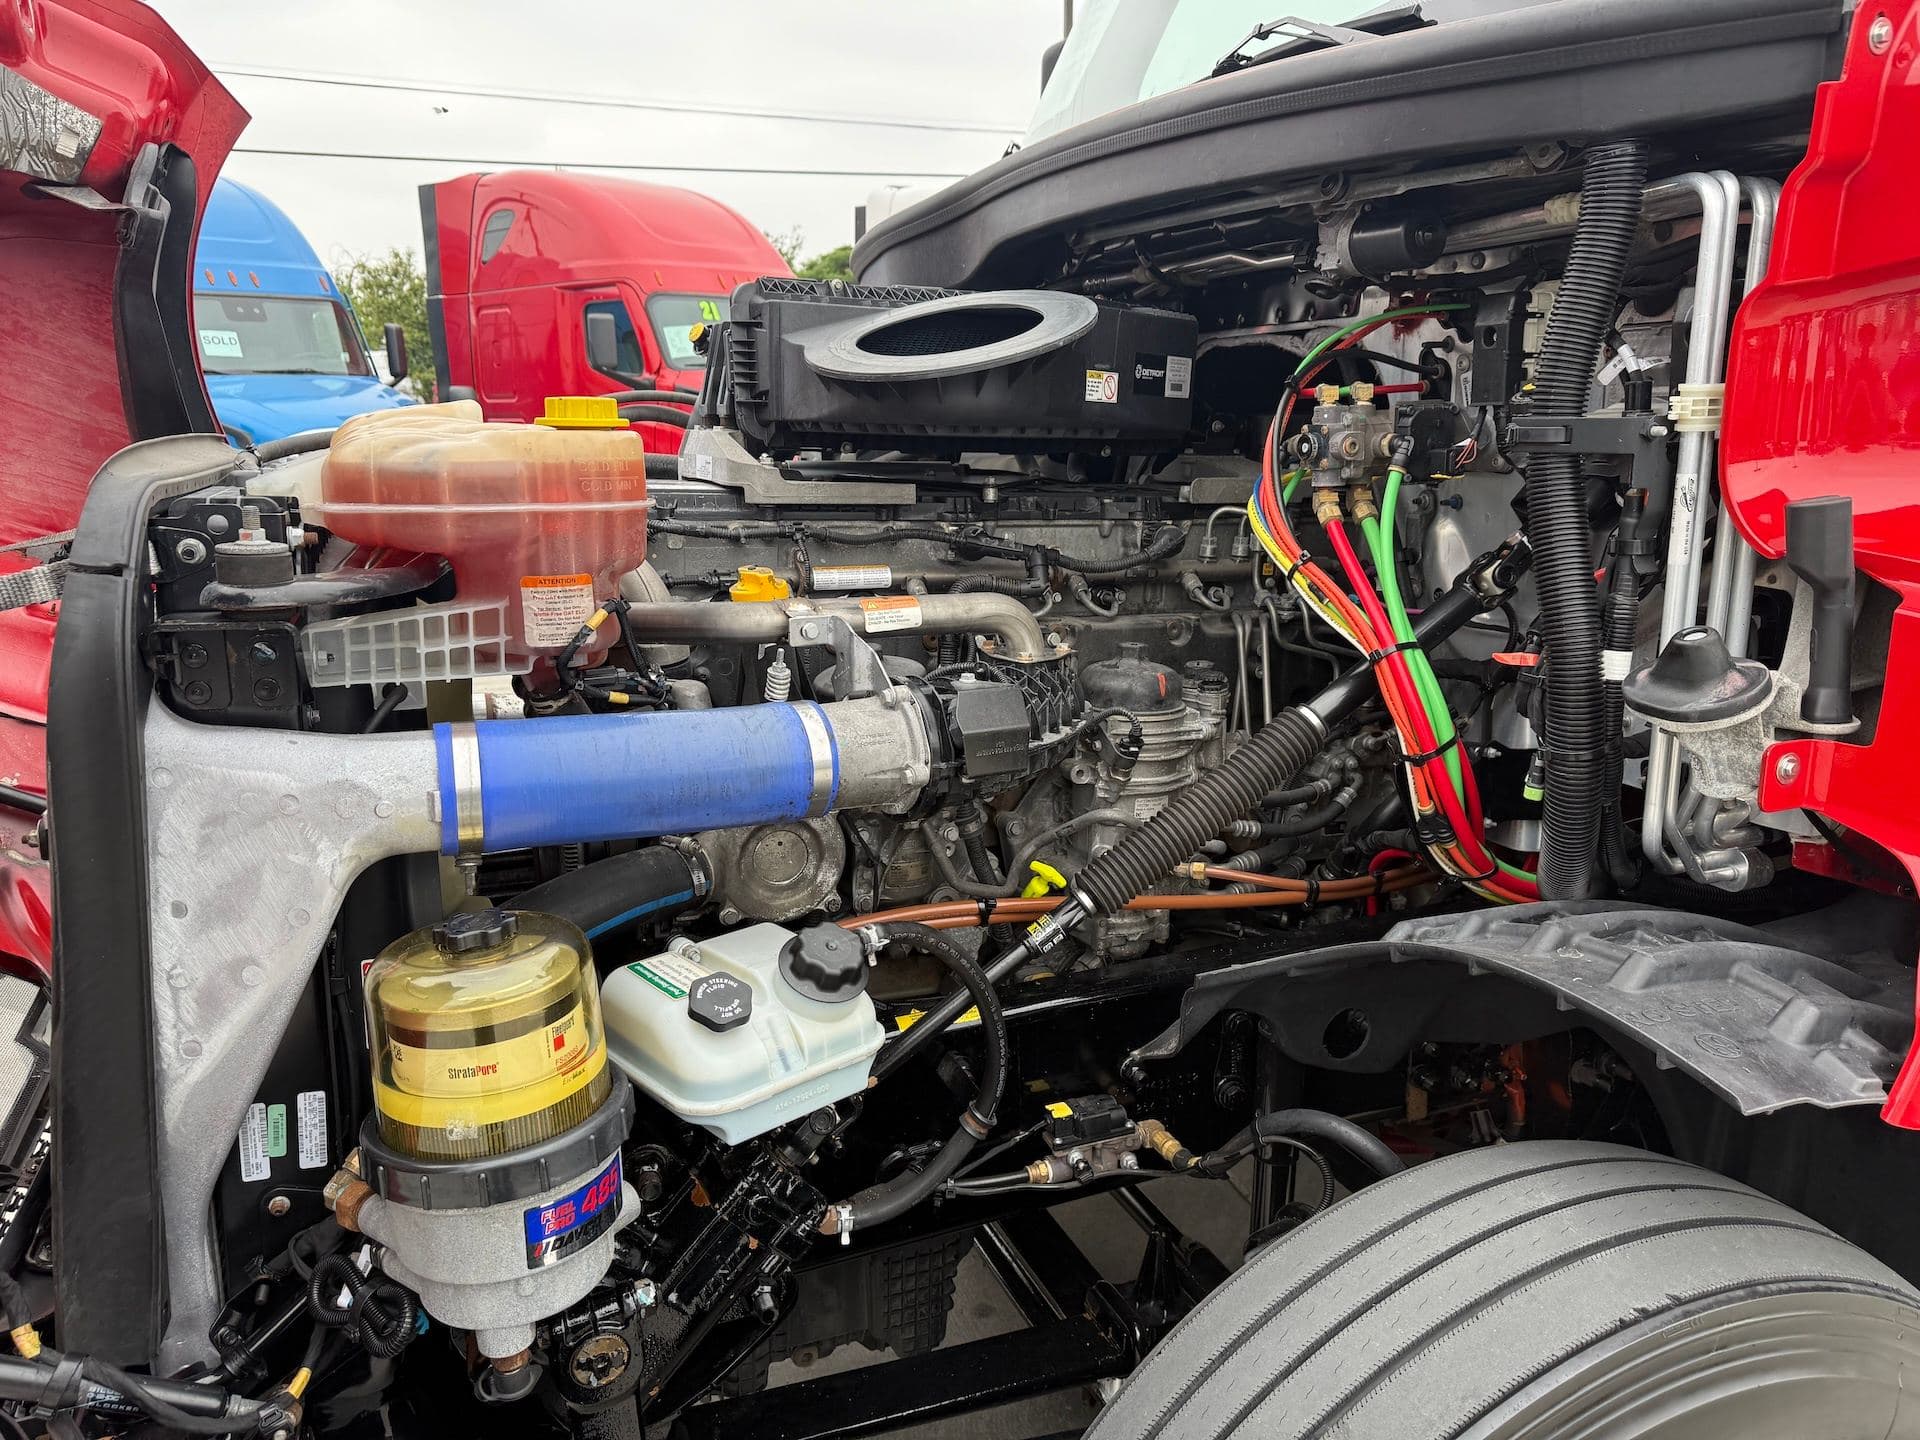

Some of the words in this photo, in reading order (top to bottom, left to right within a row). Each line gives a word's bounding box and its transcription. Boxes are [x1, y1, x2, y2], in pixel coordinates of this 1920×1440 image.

[698, 300, 720, 321] 21
[202, 336, 238, 345] SOLD
[1142, 369, 1164, 377] DETROIT
[706, 984, 724, 993] FLUID
[709, 978, 738, 988] STEERING
[551, 1016, 574, 1038] Fleetguard
[582, 1166, 618, 1213] 485
[541, 1200, 576, 1224] FUEL
[544, 1212, 576, 1235] PRO
